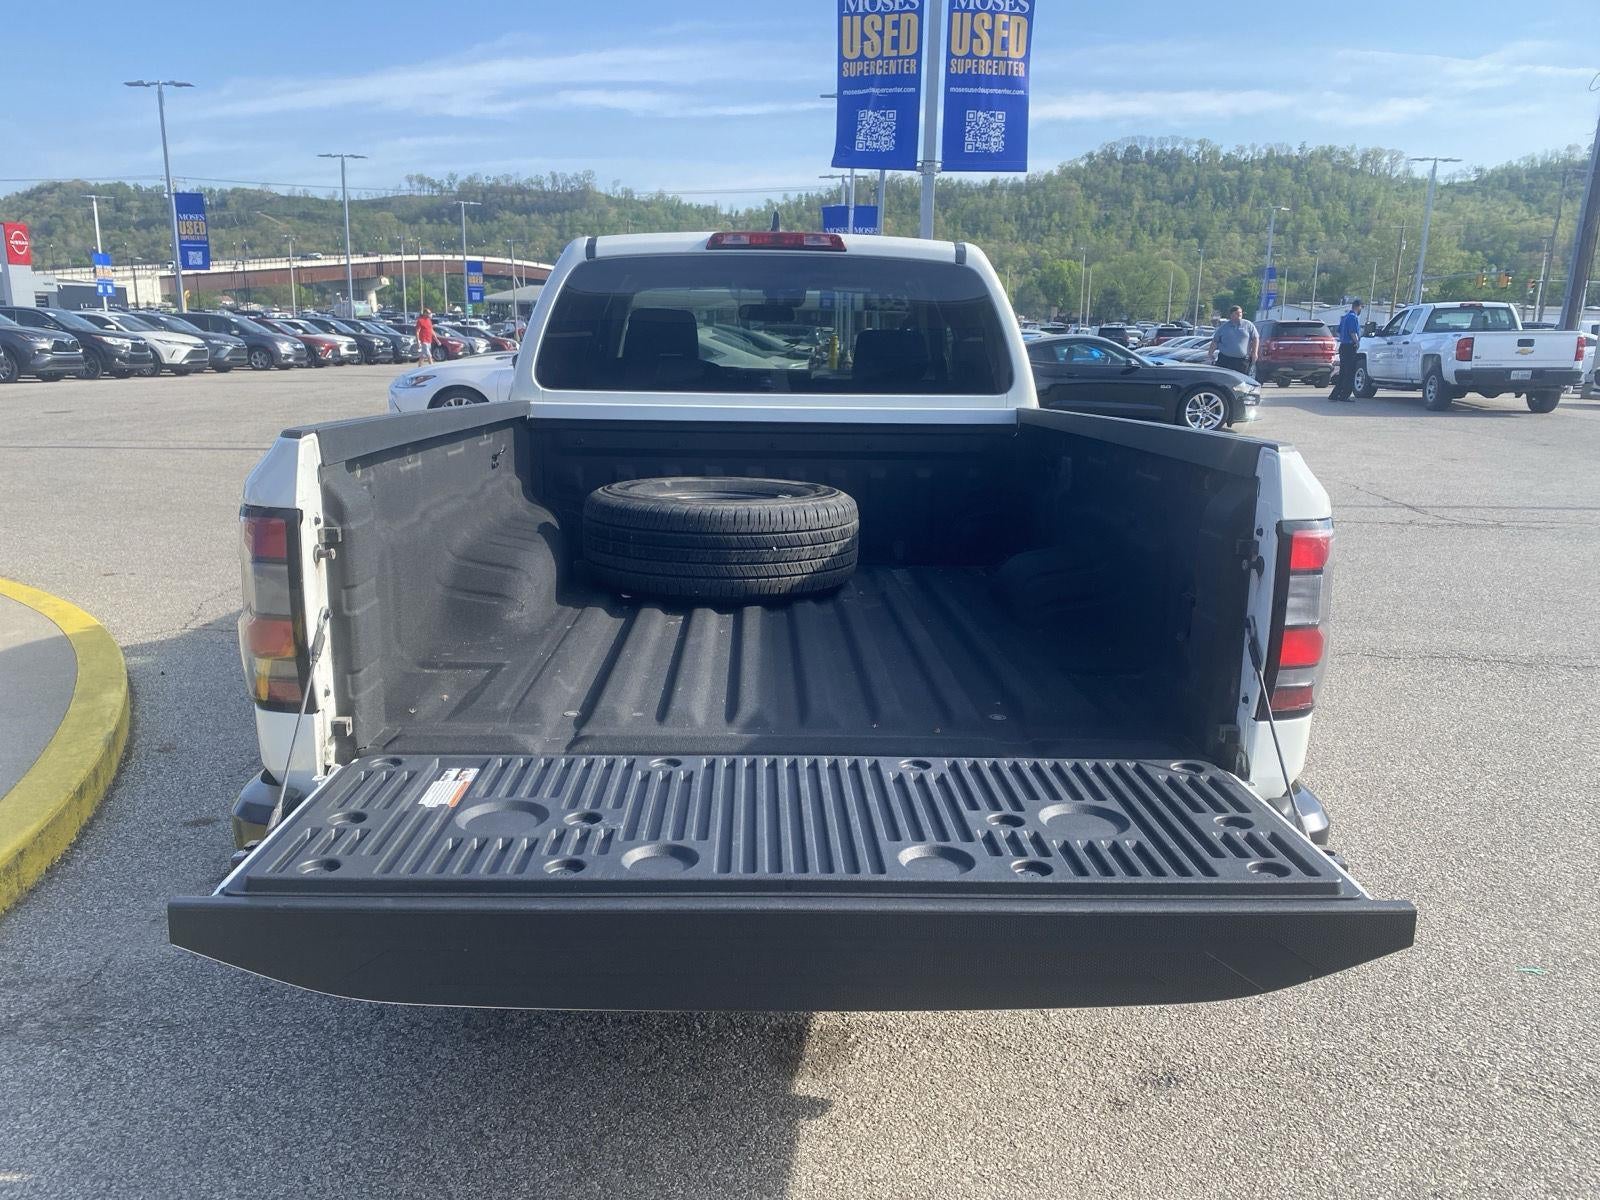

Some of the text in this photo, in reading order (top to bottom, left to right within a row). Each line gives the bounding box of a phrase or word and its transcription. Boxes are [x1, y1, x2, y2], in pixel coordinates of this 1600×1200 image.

[843, 0, 920, 13] MOSES
[953, 0, 1030, 13] MOSES
[842, 14, 919, 59] USED
[950, 12, 1028, 59] USED
[842, 59, 917, 77] SUPERCENTER
[950, 59, 1025, 77] SUPERCENTER
[842, 87, 916, 96] mosesusedsupercenter.com
[949, 87, 1025, 95] mosesusedsupercenter.com
[178, 221, 207, 235] USED
